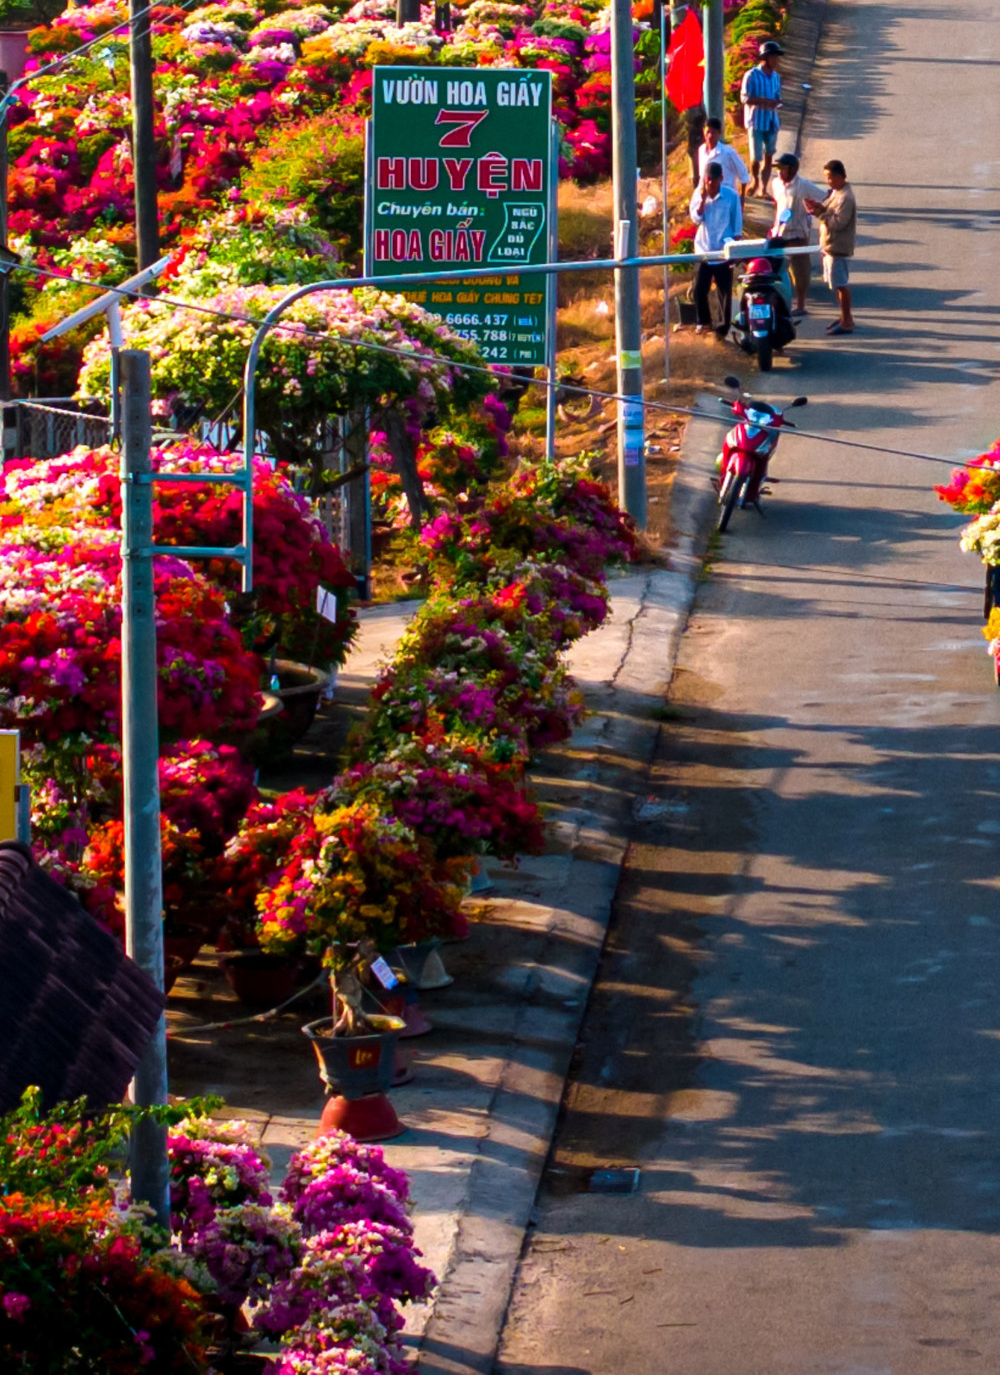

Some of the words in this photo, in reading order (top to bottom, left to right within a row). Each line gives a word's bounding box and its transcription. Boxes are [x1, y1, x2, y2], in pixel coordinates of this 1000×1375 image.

[383, 73, 439, 105] VƯỜN
[447, 80, 487, 105] HOA
[497, 72, 543, 107] GIẤY
[434, 108, 489, 148] 7
[377, 152, 543, 199] HUYỆN
[377, 201, 443, 217] Chuyên
[374, 228, 422, 261] HOA
[429, 218, 486, 262] GIẤY
[498, 247, 525, 258] LOẠI
[432, 292, 453, 303] HOA
